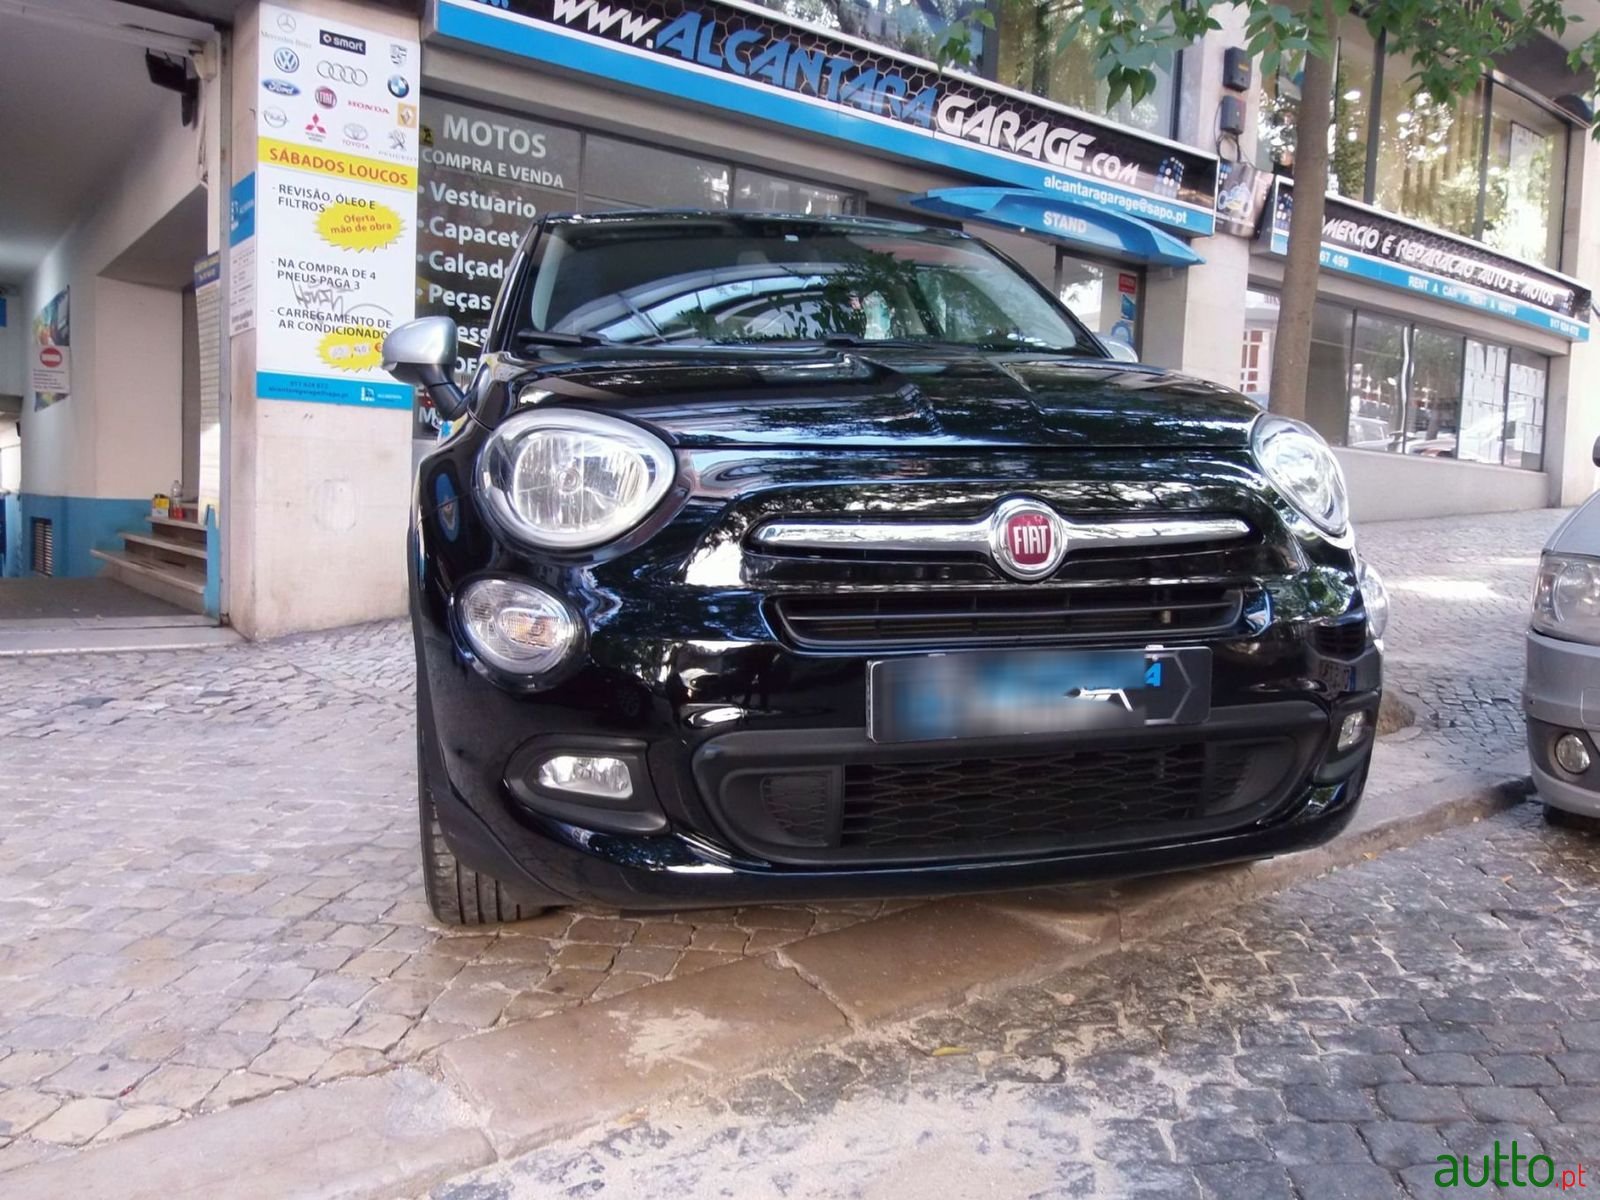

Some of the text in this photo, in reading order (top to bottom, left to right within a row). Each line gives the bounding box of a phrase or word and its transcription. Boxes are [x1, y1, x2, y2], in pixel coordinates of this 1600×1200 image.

[347, 100, 390, 114] HONDA
[442, 114, 547, 159] MOTOS
[269, 147, 409, 186] SÁBADOS LOUCOS
[421, 148, 564, 189] COMPRA E VENDA
[278, 196, 326, 213] FILTROS
[335, 193, 367, 209] ÓLEO
[369, 200, 377, 210] E
[430, 181, 537, 219] Vestuario
[1043, 175, 1188, 224] alcantaragarage@sapo.pt
[343, 214, 376, 224] Oferta
[355, 223, 367, 232] de
[369, 222, 392, 232] obra
[1043, 210, 1088, 234] STAND
[429, 215, 520, 248] Capacet
[1321, 215, 1380, 250] MERCIO
[1381, 234, 1396, 255] E
[277, 257, 376, 280] NA COMPRA DE 4
[277, 270, 361, 291] PNEUS PAGA 3
[428, 284, 492, 318] Peças
[277, 306, 392, 330] CARREGAMENTO DE
[278, 318, 389, 341] AR CONDICIONADO
[1012, 524, 1049, 555] FIAT
